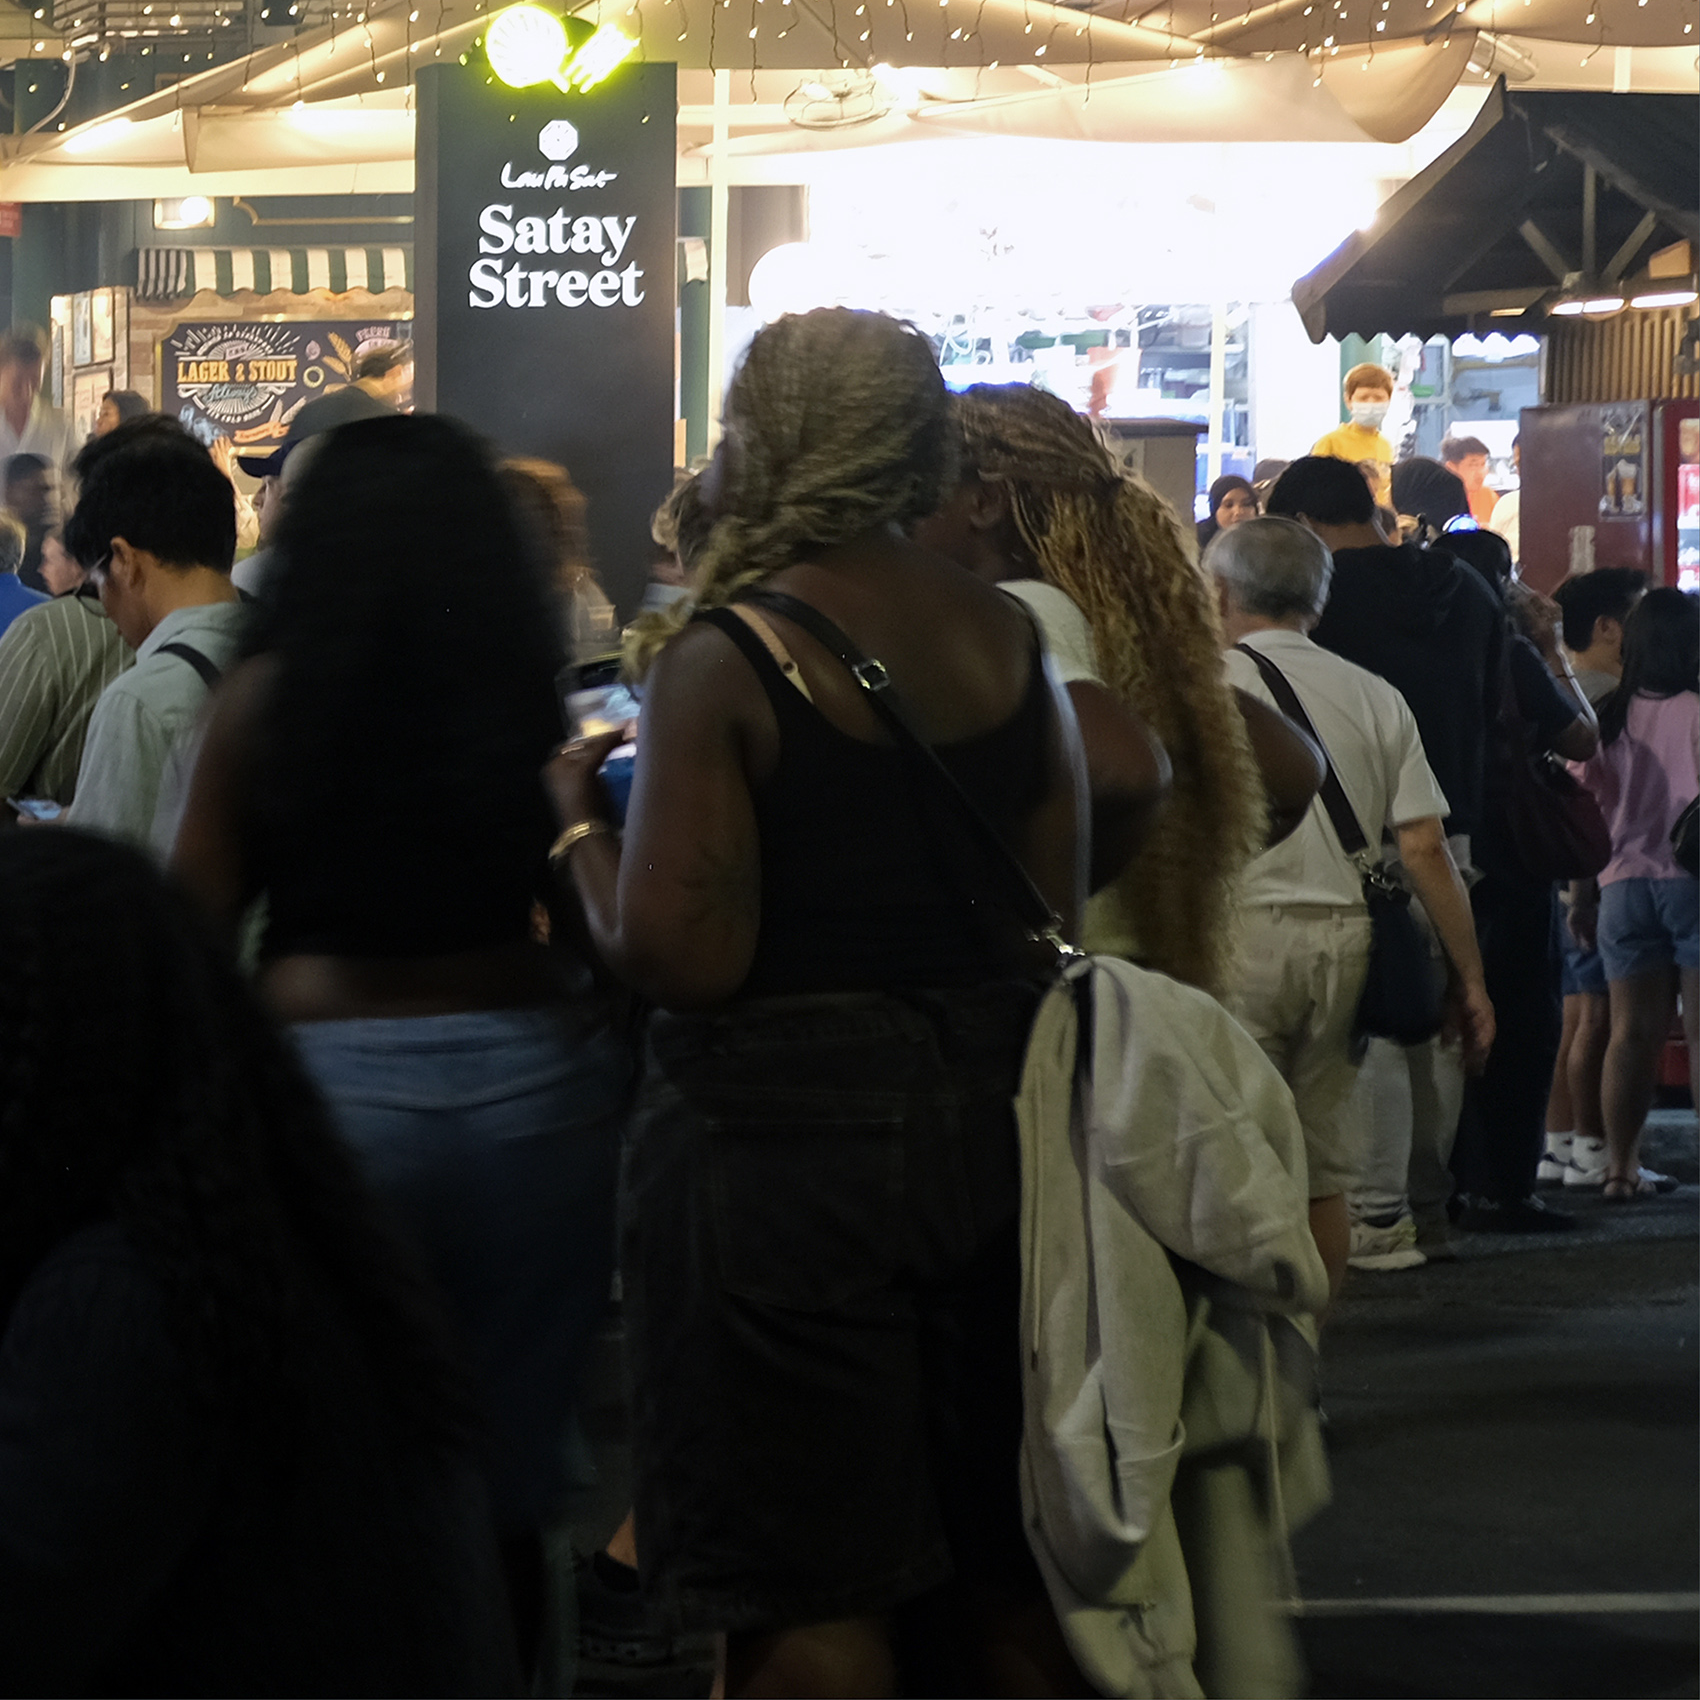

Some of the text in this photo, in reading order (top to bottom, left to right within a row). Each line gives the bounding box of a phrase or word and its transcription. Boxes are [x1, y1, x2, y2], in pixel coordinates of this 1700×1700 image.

[479, 204, 637, 267] Satay
[468, 258, 646, 308] Street
[177, 358, 298, 383] LAGER & STOUT
